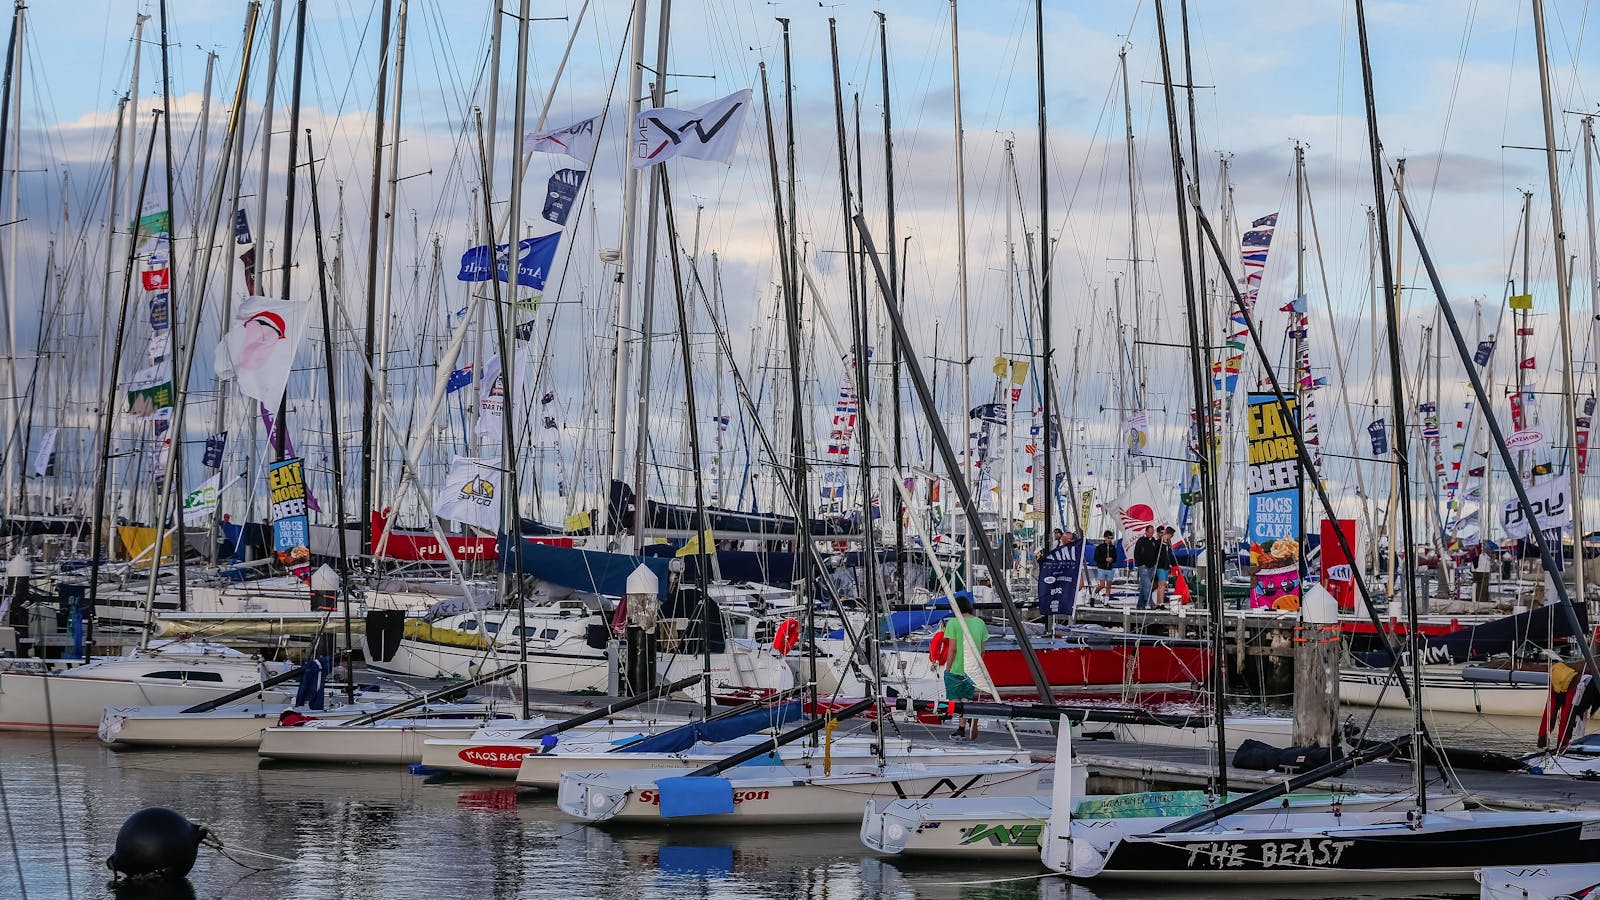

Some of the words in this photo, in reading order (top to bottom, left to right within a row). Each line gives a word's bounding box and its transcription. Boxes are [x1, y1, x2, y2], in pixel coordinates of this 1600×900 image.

[1248, 399, 1298, 441] EAT
[1249, 436, 1299, 464] MORE
[270, 461, 302, 490] EAT
[1250, 460, 1298, 494] BEEF
[272, 483, 305, 504] MORE
[273, 499, 306, 520] BEEF
[1256, 496, 1292, 514] HOGS
[279, 520, 303, 531] HOGS
[1256, 513, 1292, 523] BREATH
[1256, 523, 1292, 538] CAFE
[280, 538, 304, 547] CAFE
[420, 544, 443, 556] FU
[458, 544, 484, 554] and
[1368, 675, 1402, 686] TRIM
[465, 751, 498, 762] KAOS
[499, 753, 525, 761] RAC
[1186, 841, 1249, 869] THE
[1261, 838, 1356, 868] BEAST
